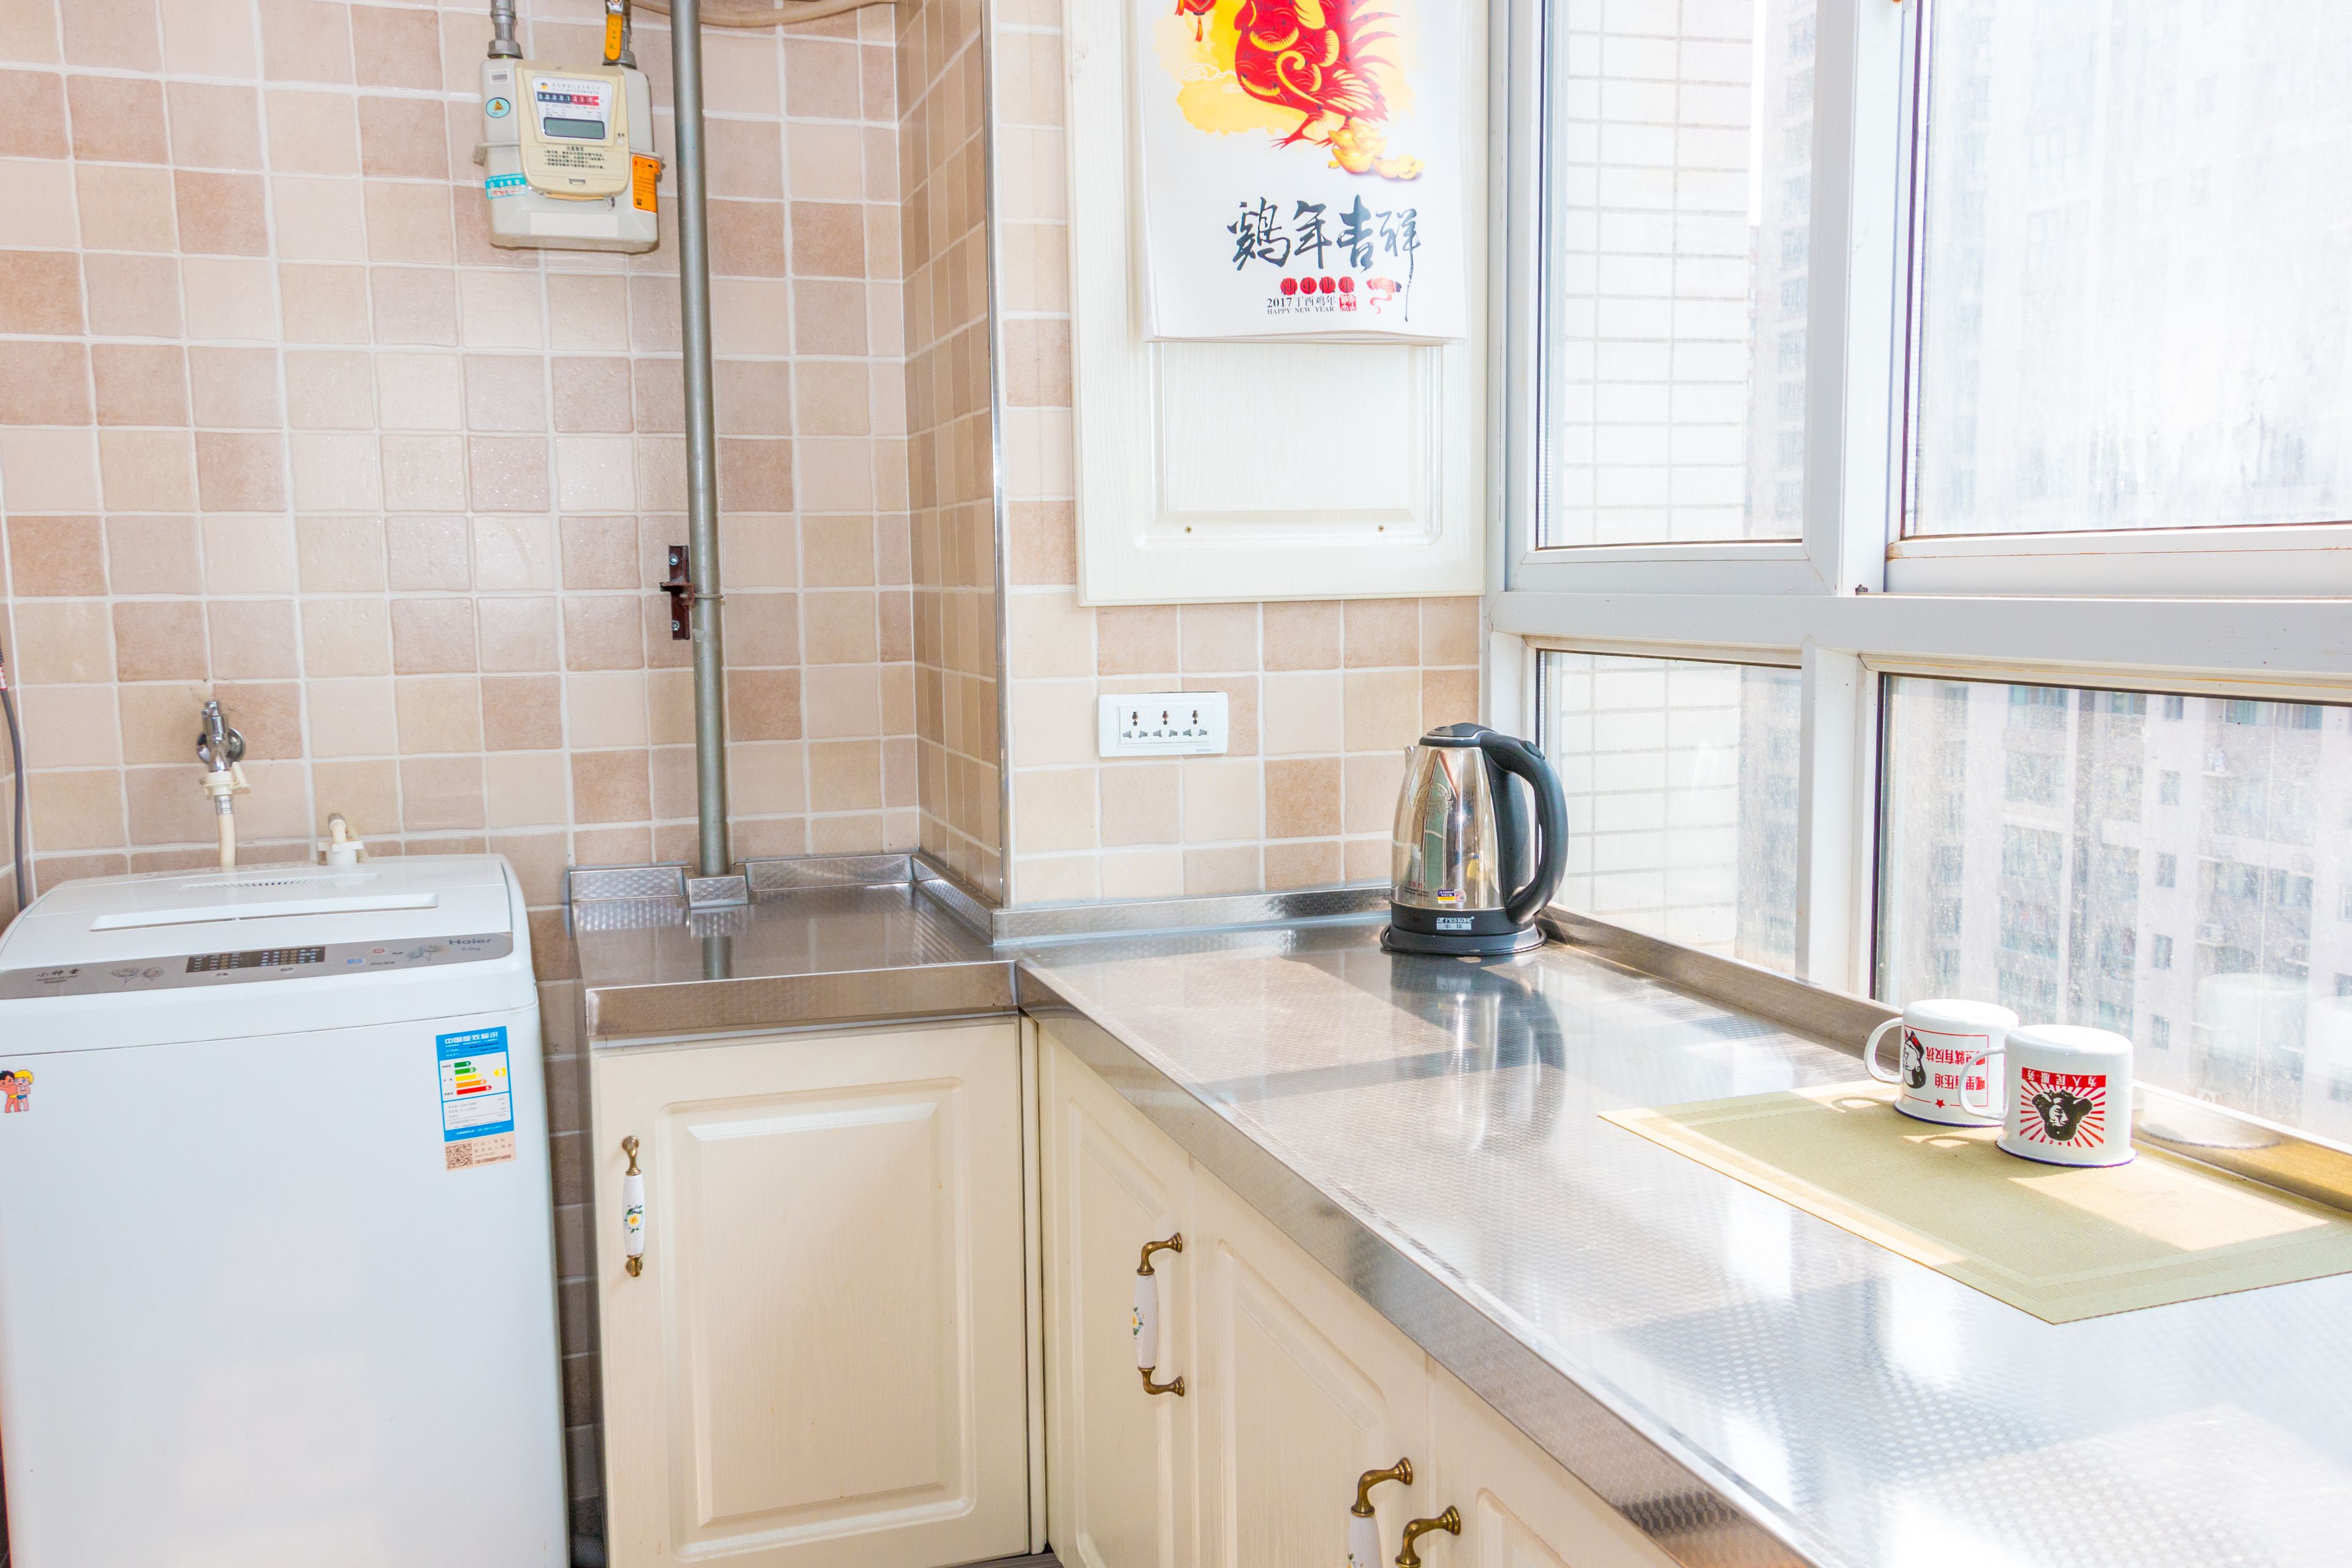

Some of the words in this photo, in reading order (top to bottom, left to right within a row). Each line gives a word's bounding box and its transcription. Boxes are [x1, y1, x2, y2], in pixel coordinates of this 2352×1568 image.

[1267, 297, 1292, 308] 2017
[2027, 1069, 2097, 1087] 为人民服务
